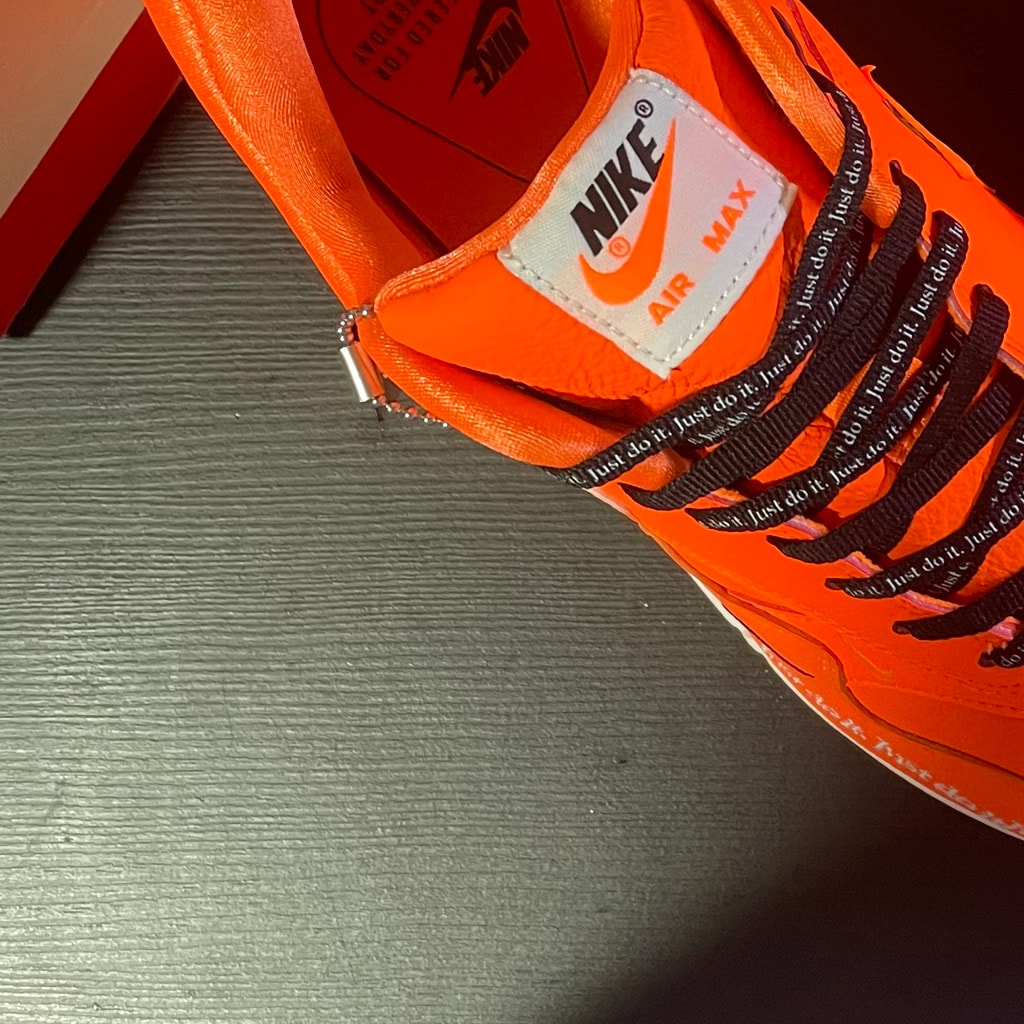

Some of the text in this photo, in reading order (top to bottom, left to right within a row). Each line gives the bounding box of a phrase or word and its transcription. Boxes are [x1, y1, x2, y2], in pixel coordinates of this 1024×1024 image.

[374, 45, 410, 81] FOR
[474, 12, 531, 97] NIKE
[852, 139, 865, 155] it.
[845, 160, 862, 185] do
[828, 188, 855, 224] Just
[647, 178, 757, 326] AIR MAX
[818, 228, 838, 242] it.
[810, 246, 828, 269] do
[796, 271, 819, 310] Just
[842, 422, 862, 445] do
[854, 405, 875, 419] it.
[866, 366, 894, 403] Just
[889, 340, 908, 363] do
[899, 323, 919, 338] it.
[910, 283, 938, 320] Just
[931, 259, 950, 281] do
[941, 244, 959, 257] it.
[587, 454, 626, 483] Just
[628, 439, 651, 458] do
[651, 428, 672, 442] it.
[673, 406, 711, 435] Just
[713, 394, 737, 412] do
[737, 383, 759, 398] it.
[760, 354, 791, 388] Just
[794, 335, 812, 355] do
[828, 278, 850, 316] Just
[748, 500, 783, 526] Just
[785, 489, 808, 506] do
[808, 479, 829, 493] it.
[829, 457, 865, 486] Just
[866, 441, 886, 459] do
[886, 426, 903, 440] it.
[902, 386, 929, 421] Just
[997, 471, 1014, 493] do
[1006, 453, 1024, 468] it.
[886, 567, 921, 592] Just
[922, 557, 945, 572] do
[944, 546, 965, 559] it.
[964, 521, 998, 552] Just
[1000, 504, 1020, 524] do
[1001, 654, 1021, 666] do
